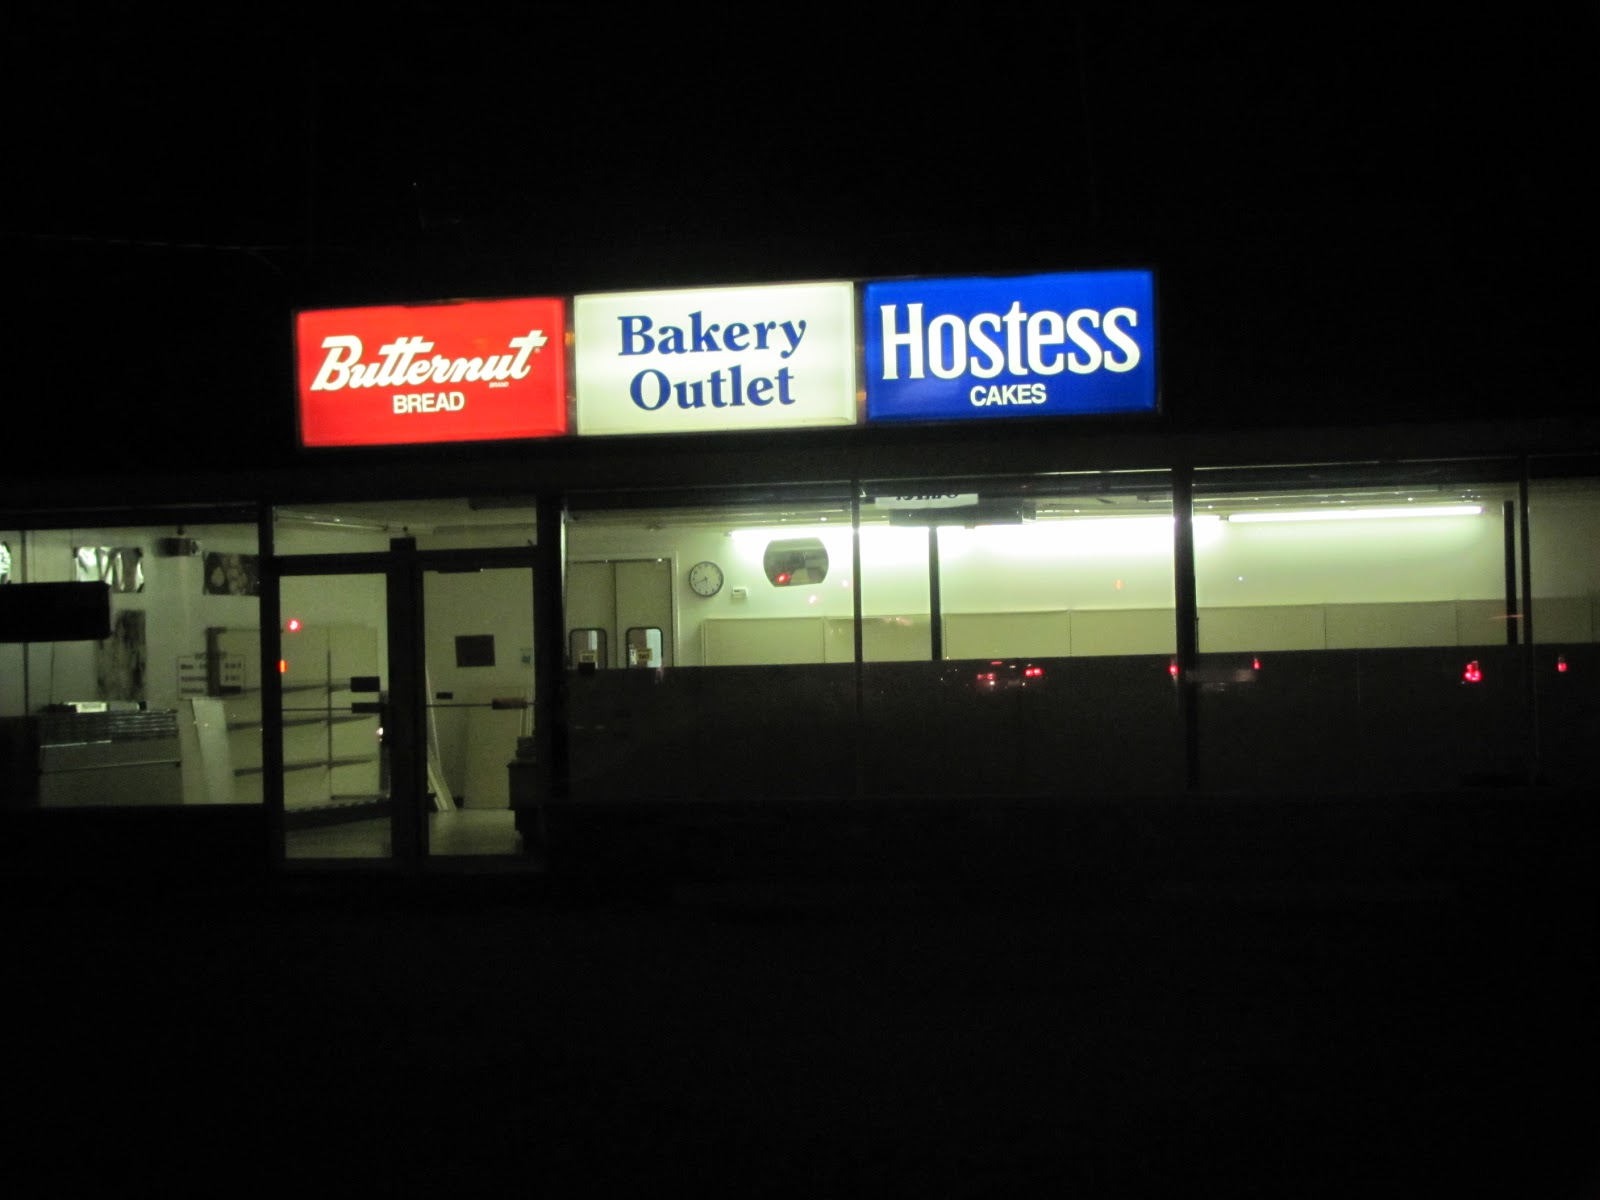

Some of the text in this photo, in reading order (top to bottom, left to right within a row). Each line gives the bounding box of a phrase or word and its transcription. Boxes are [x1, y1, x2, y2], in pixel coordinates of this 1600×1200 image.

[617, 311, 807, 359] Bakery
[880, 300, 1141, 380] Hostess
[310, 329, 548, 391] Butternut
[392, 391, 466, 414] BREAD
[629, 364, 795, 411] Outlet
[969, 382, 1047, 407] CAKES
